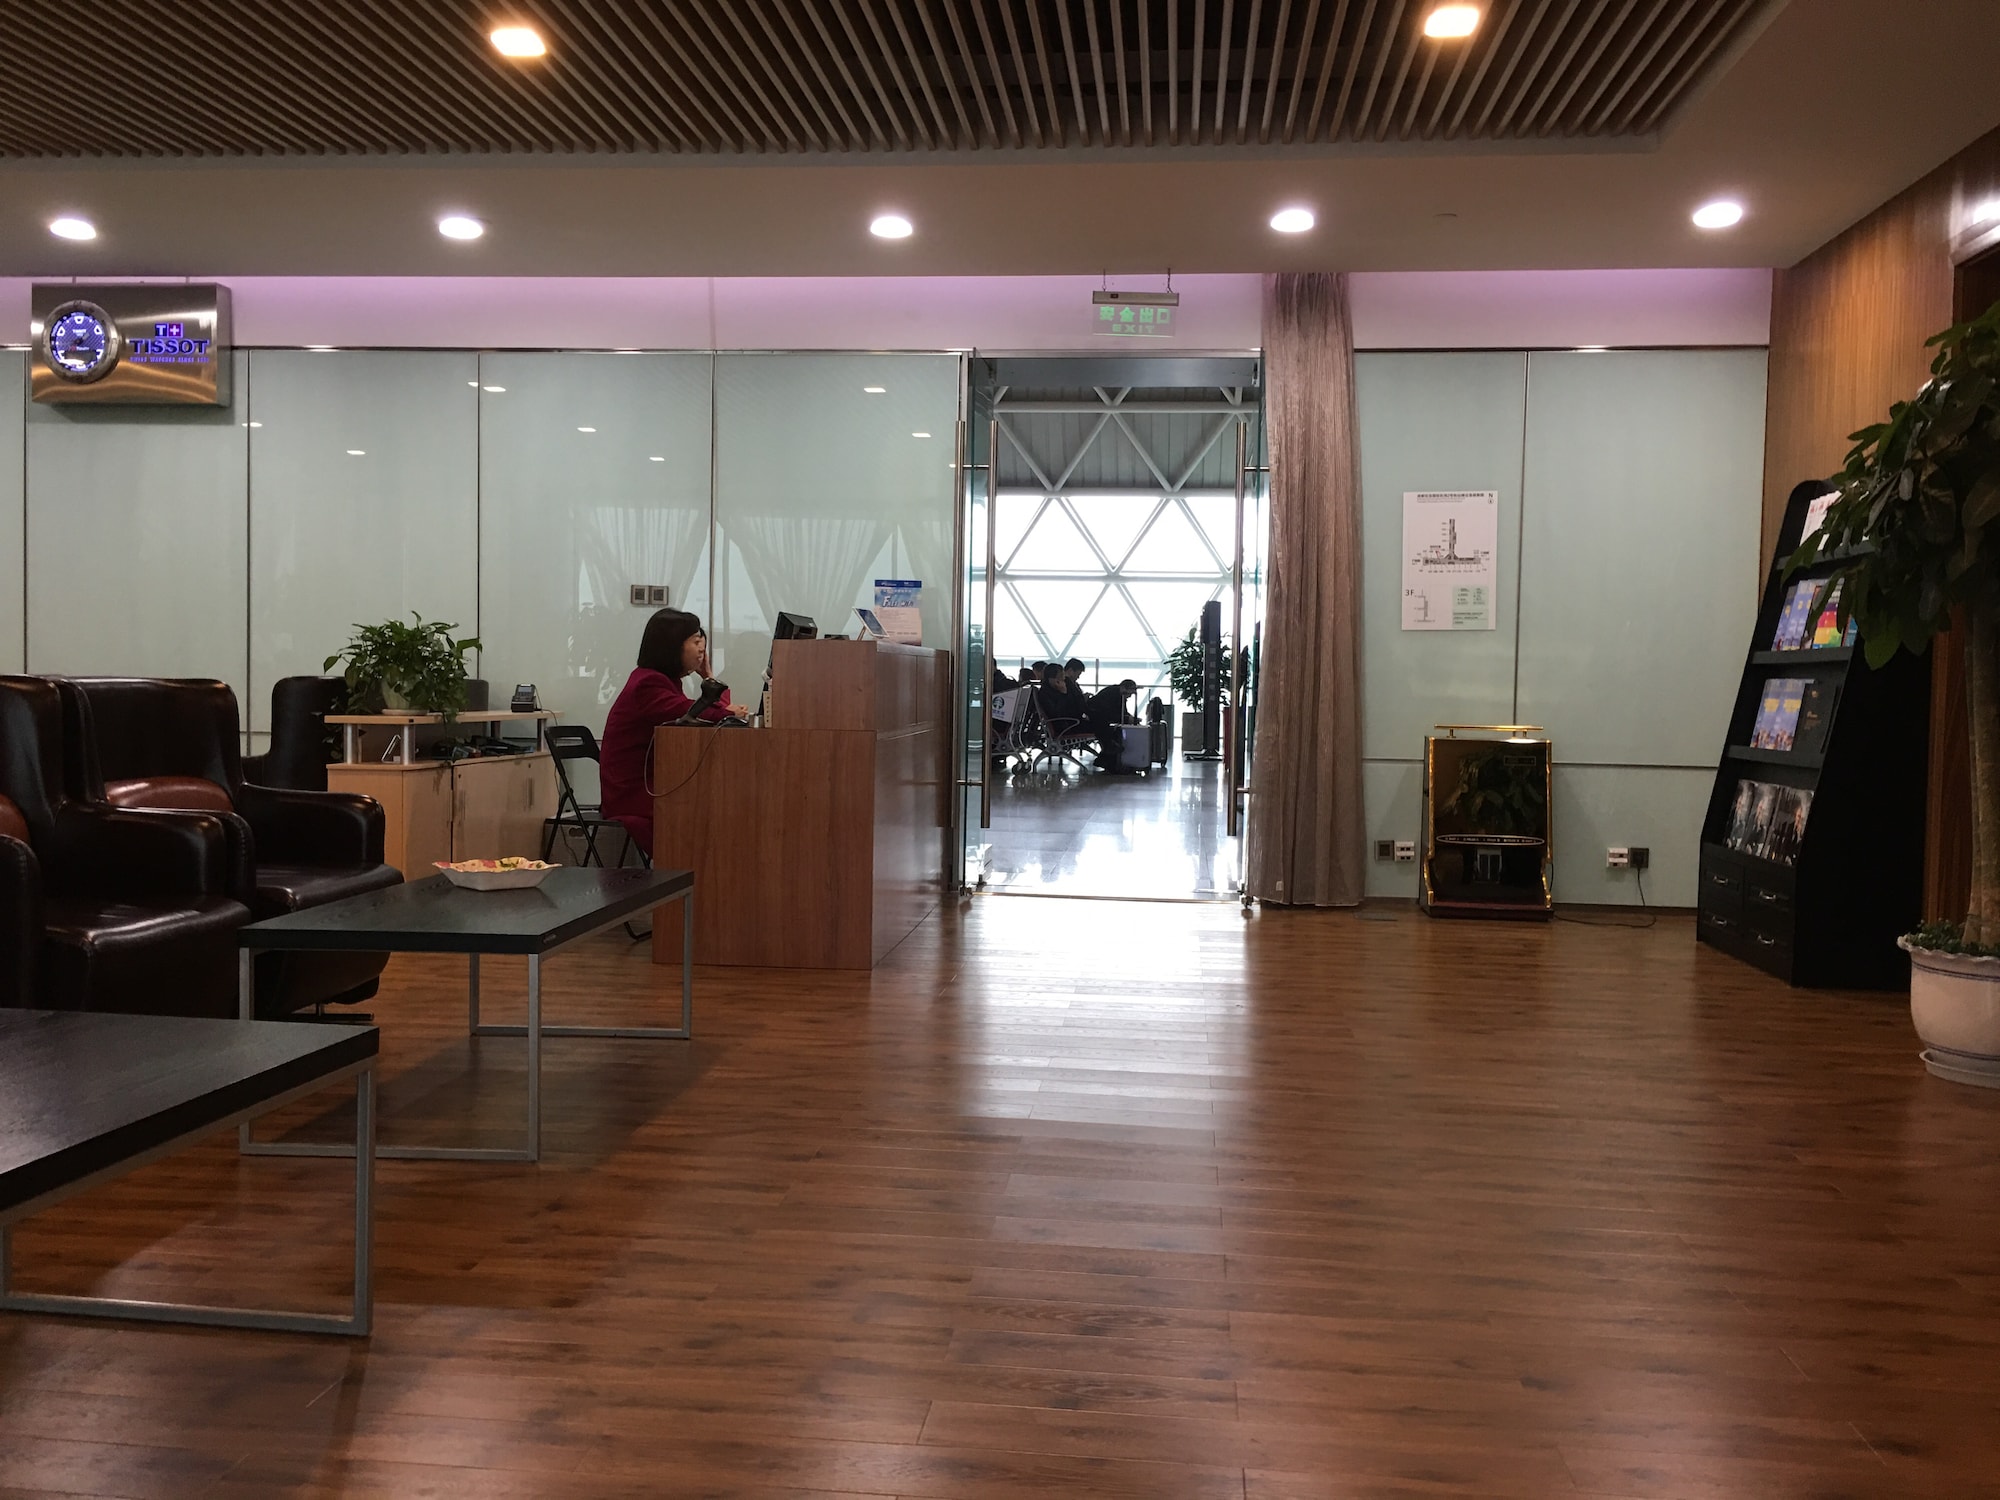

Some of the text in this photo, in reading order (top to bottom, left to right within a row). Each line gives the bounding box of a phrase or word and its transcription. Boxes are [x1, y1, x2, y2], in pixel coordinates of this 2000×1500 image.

[1112, 324, 1154, 334] EXIT
[129, 338, 209, 355] TISSOT
[1404, 589, 1415, 597] 3F
